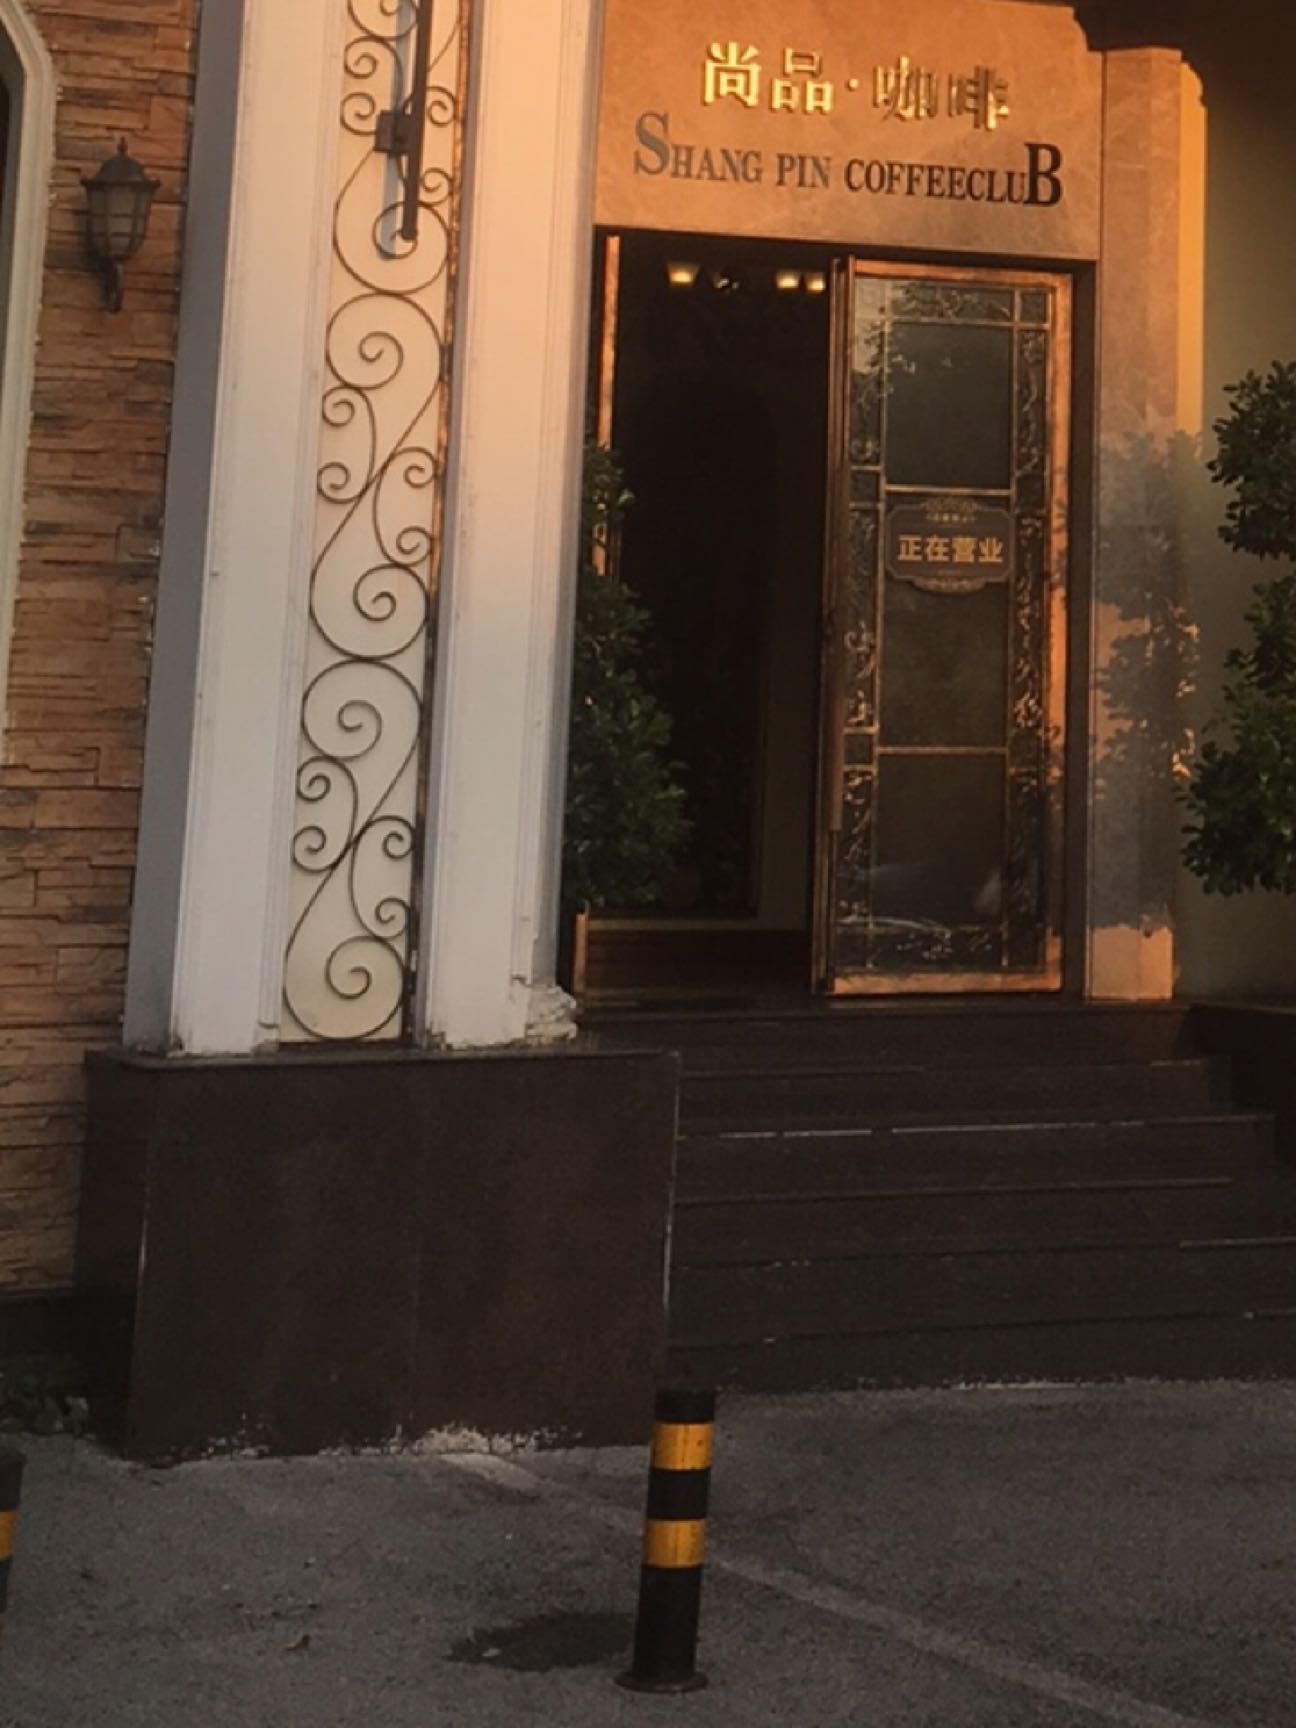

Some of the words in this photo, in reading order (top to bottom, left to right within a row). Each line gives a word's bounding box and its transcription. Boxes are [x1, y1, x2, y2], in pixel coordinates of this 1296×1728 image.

[634, 110, 764, 184] SHANG
[775, 153, 832, 189] PIN
[843, 141, 1064, 208] COFFEECLUB
[898, 535, 1003, 563] 正在营业
